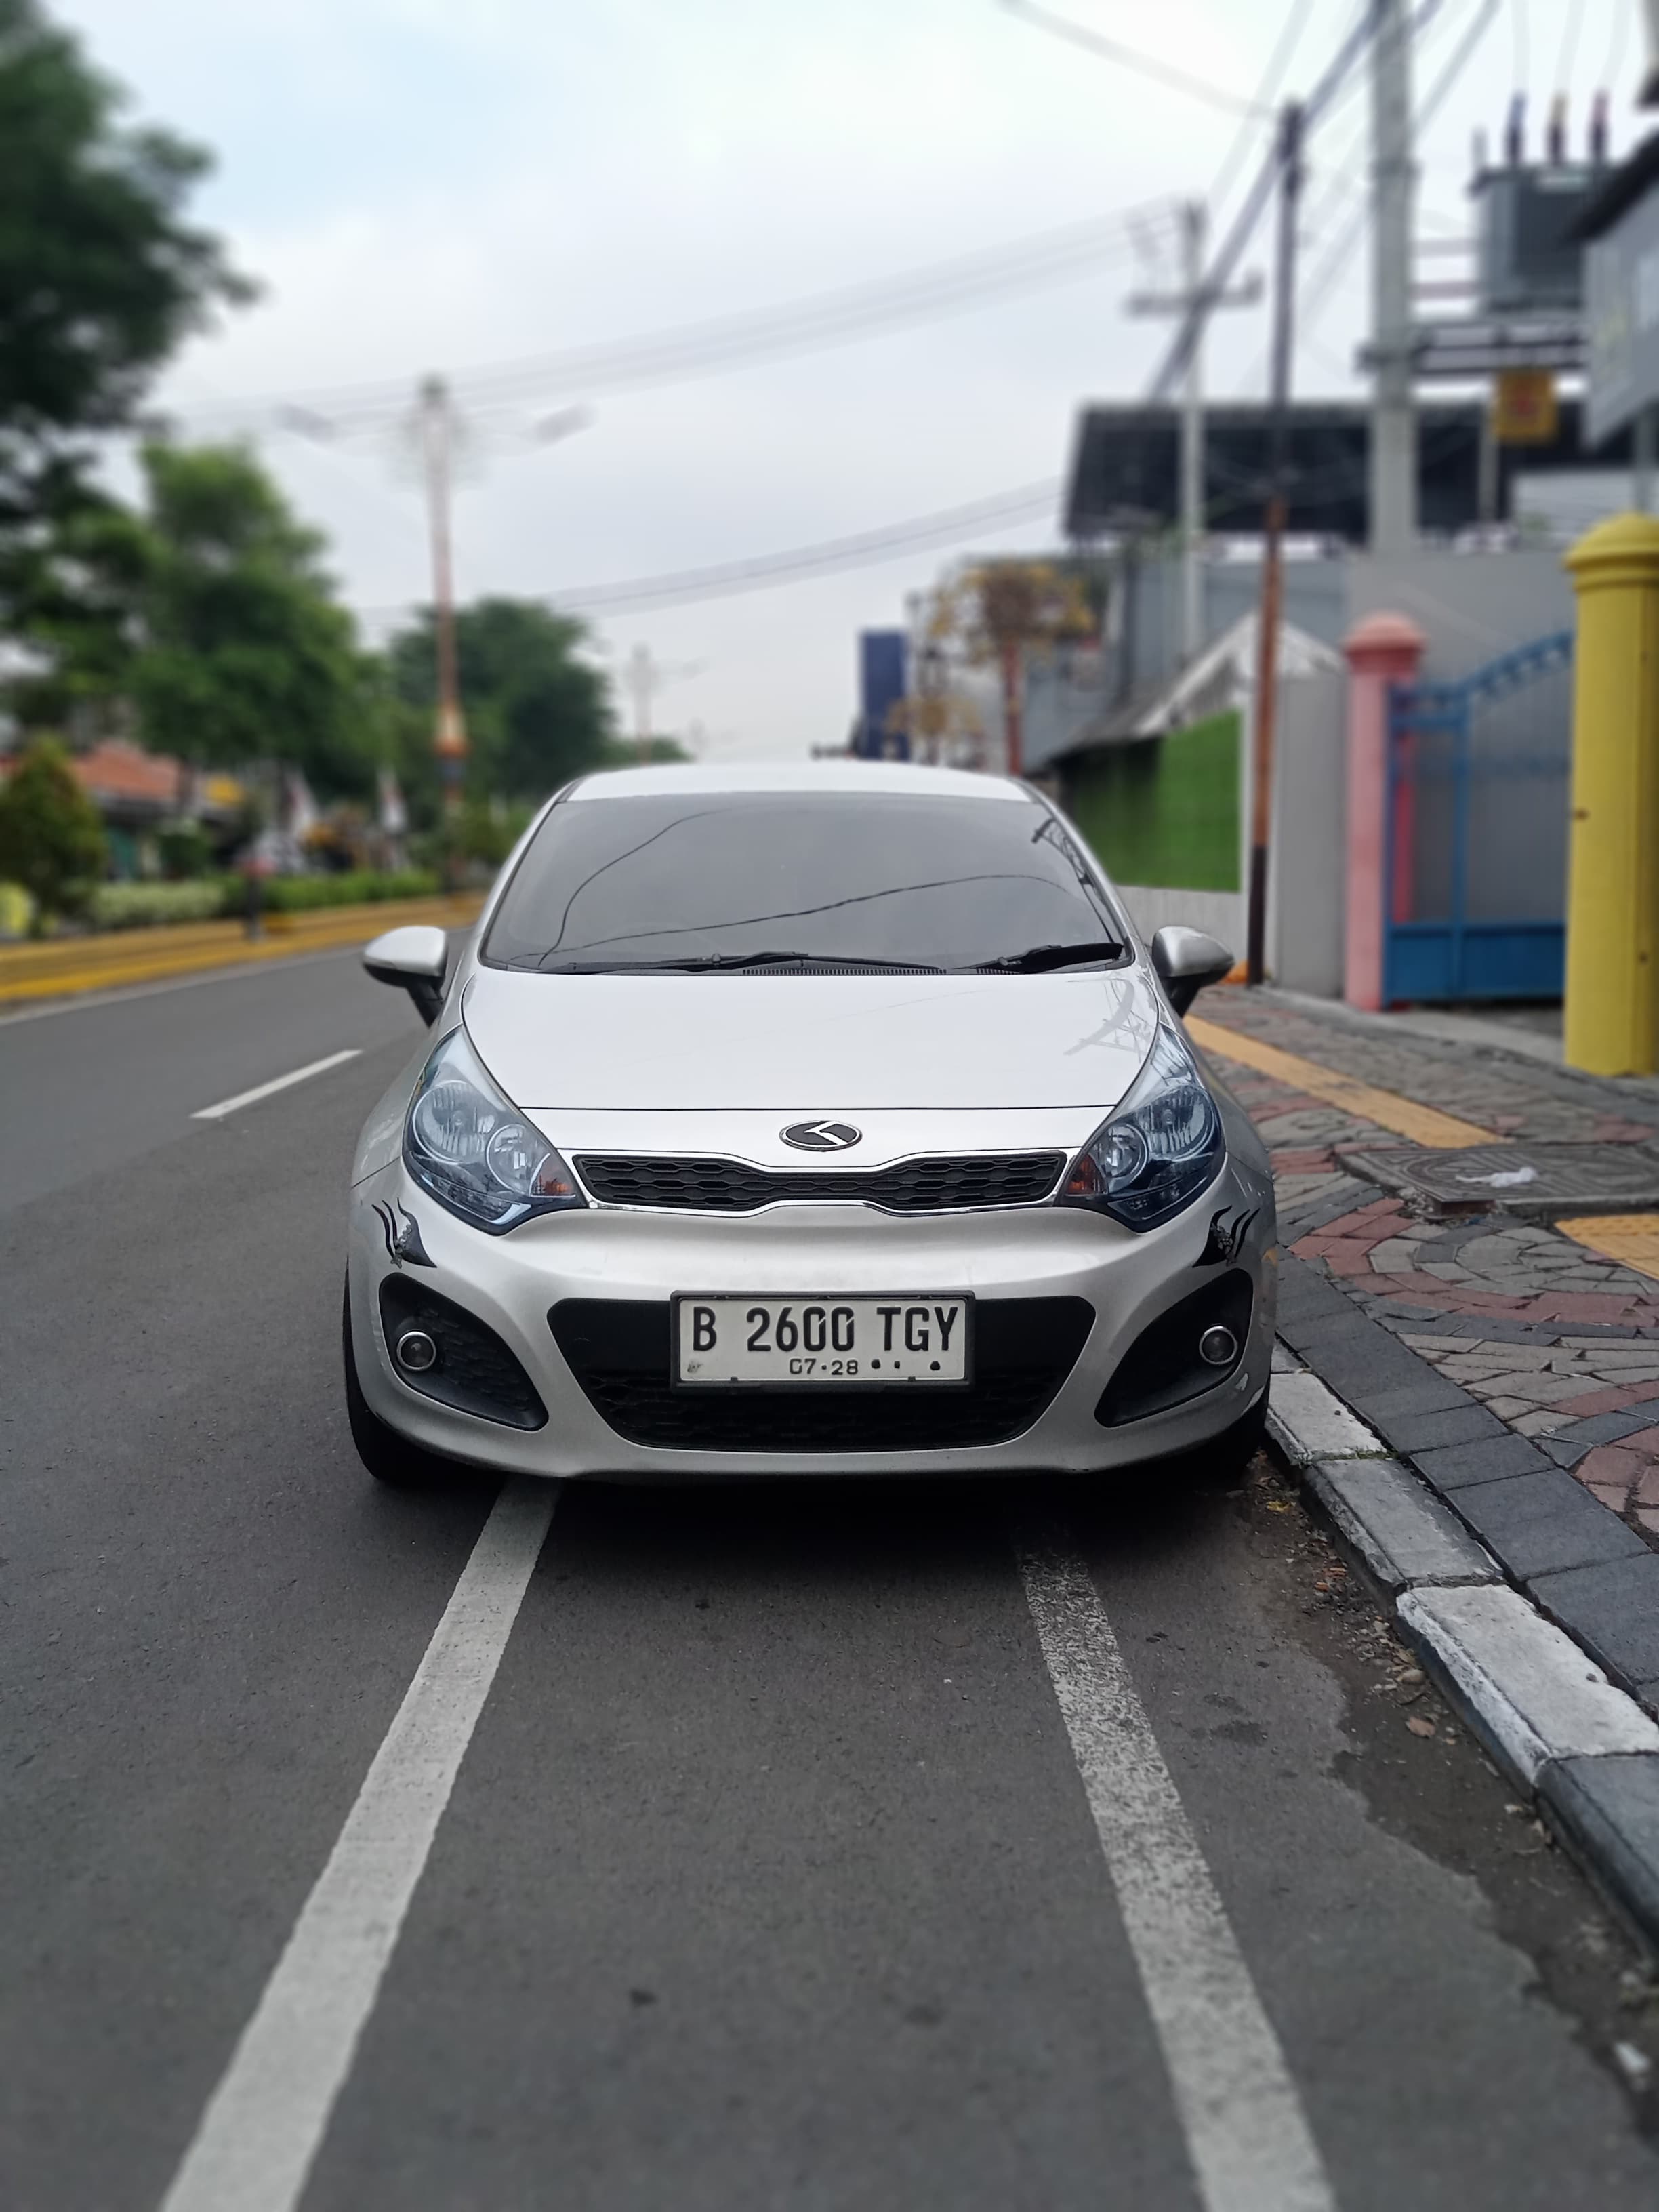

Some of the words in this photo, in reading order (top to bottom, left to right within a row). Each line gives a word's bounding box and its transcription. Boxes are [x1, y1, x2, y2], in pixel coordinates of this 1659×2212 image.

[693, 1306, 717, 1352] B
[746, 1306, 855, 1353] 2600
[876, 1306, 958, 1352] TGY
